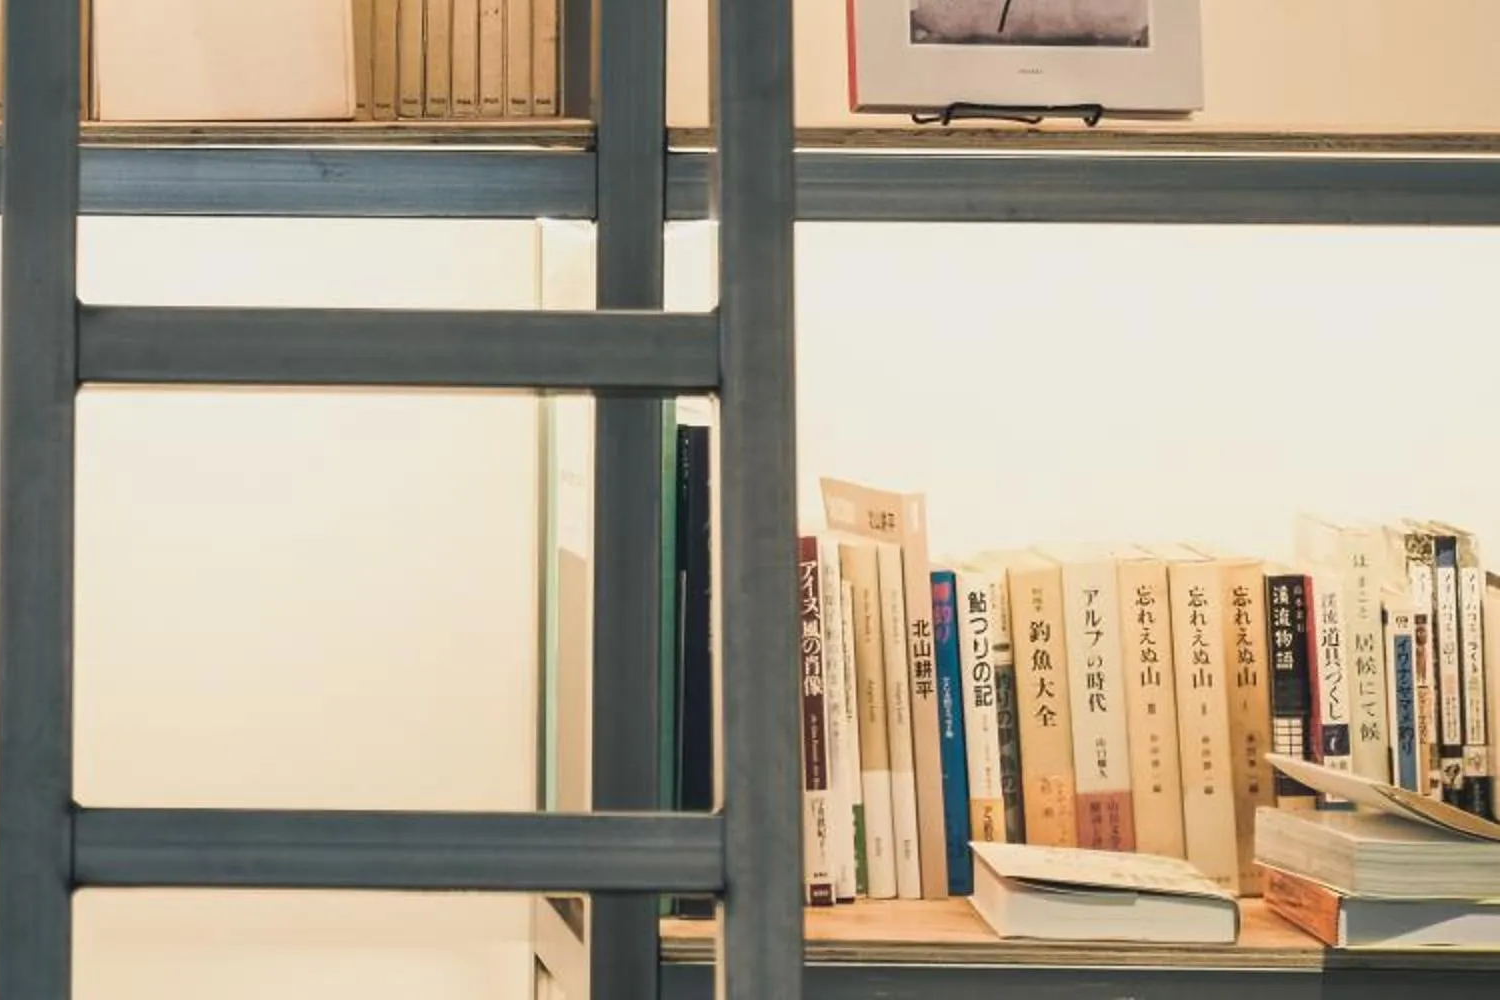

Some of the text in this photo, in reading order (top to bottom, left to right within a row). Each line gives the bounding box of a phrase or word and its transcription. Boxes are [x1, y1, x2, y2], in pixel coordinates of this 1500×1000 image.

[911, 619, 935, 700] 北山耕平
[967, 591, 993, 708] 鮎つりの記
[1028, 621, 1058, 728] 釣魚大全
[1135, 585, 1161, 688] 忘れえぬ山
[1187, 585, 1213, 689] 忘れえぬ山
[1232, 585, 1258, 688] 忘れえぬ山
